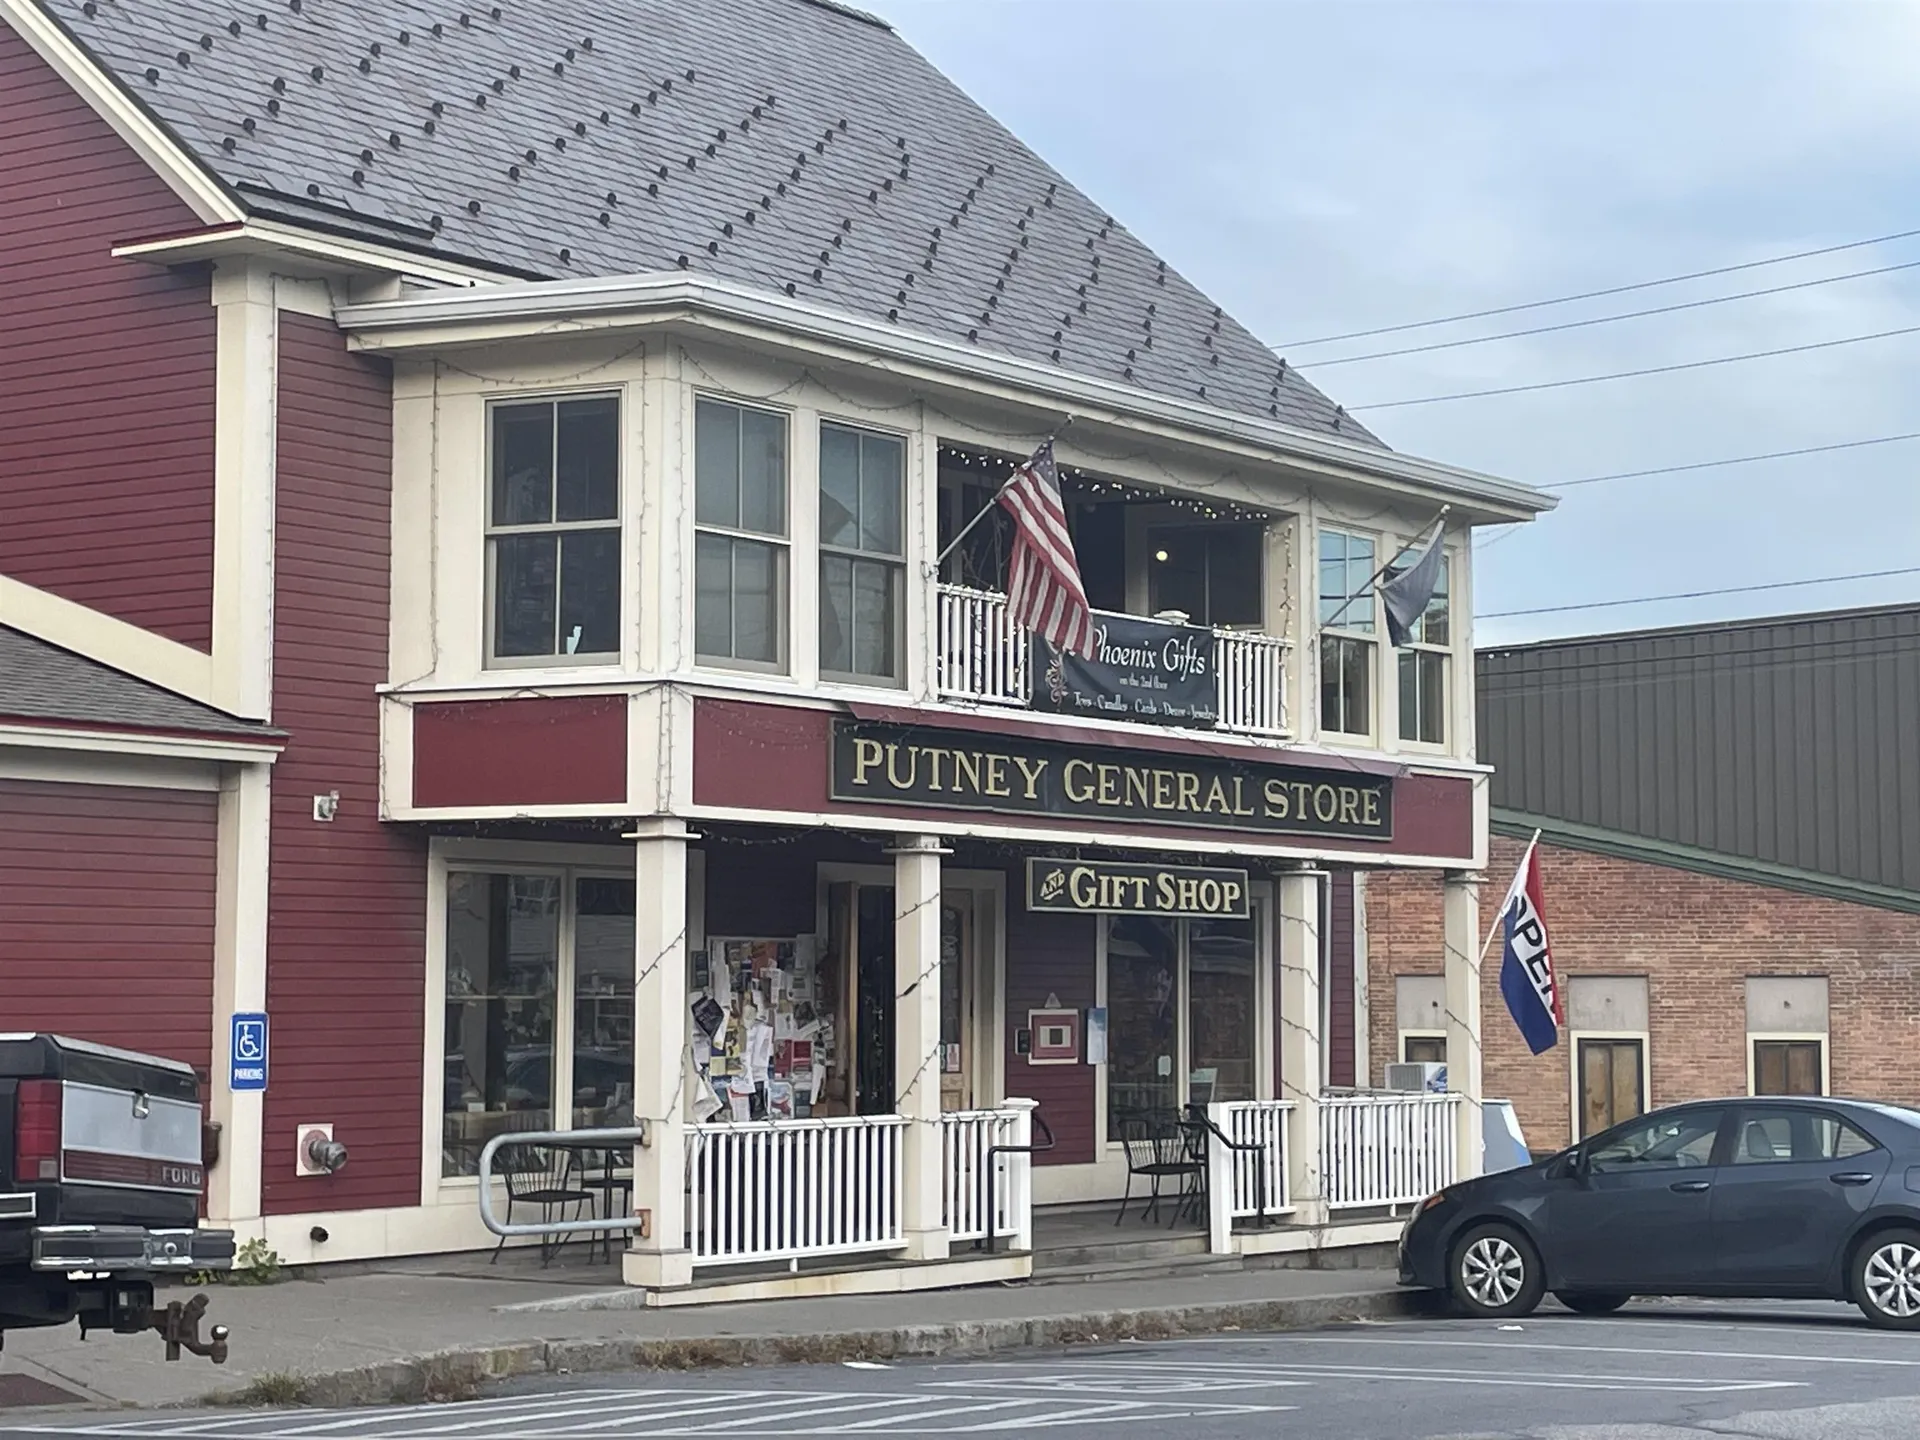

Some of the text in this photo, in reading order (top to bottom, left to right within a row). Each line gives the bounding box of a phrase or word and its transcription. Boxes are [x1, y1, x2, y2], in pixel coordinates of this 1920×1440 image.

[1162, 635, 1206, 682] Gifts
[1140, 674, 1152, 688] 2nd
[1097, 694, 1128, 712] Candles
[1134, 698, 1157, 714] Cards
[853, 738, 1381, 826] PUTNEY GENERAL STORE
[1040, 866, 1241, 912] AND GIFT SHOP
[234, 1068, 263, 1081] PARKING
[162, 1165, 201, 1185] FORD
